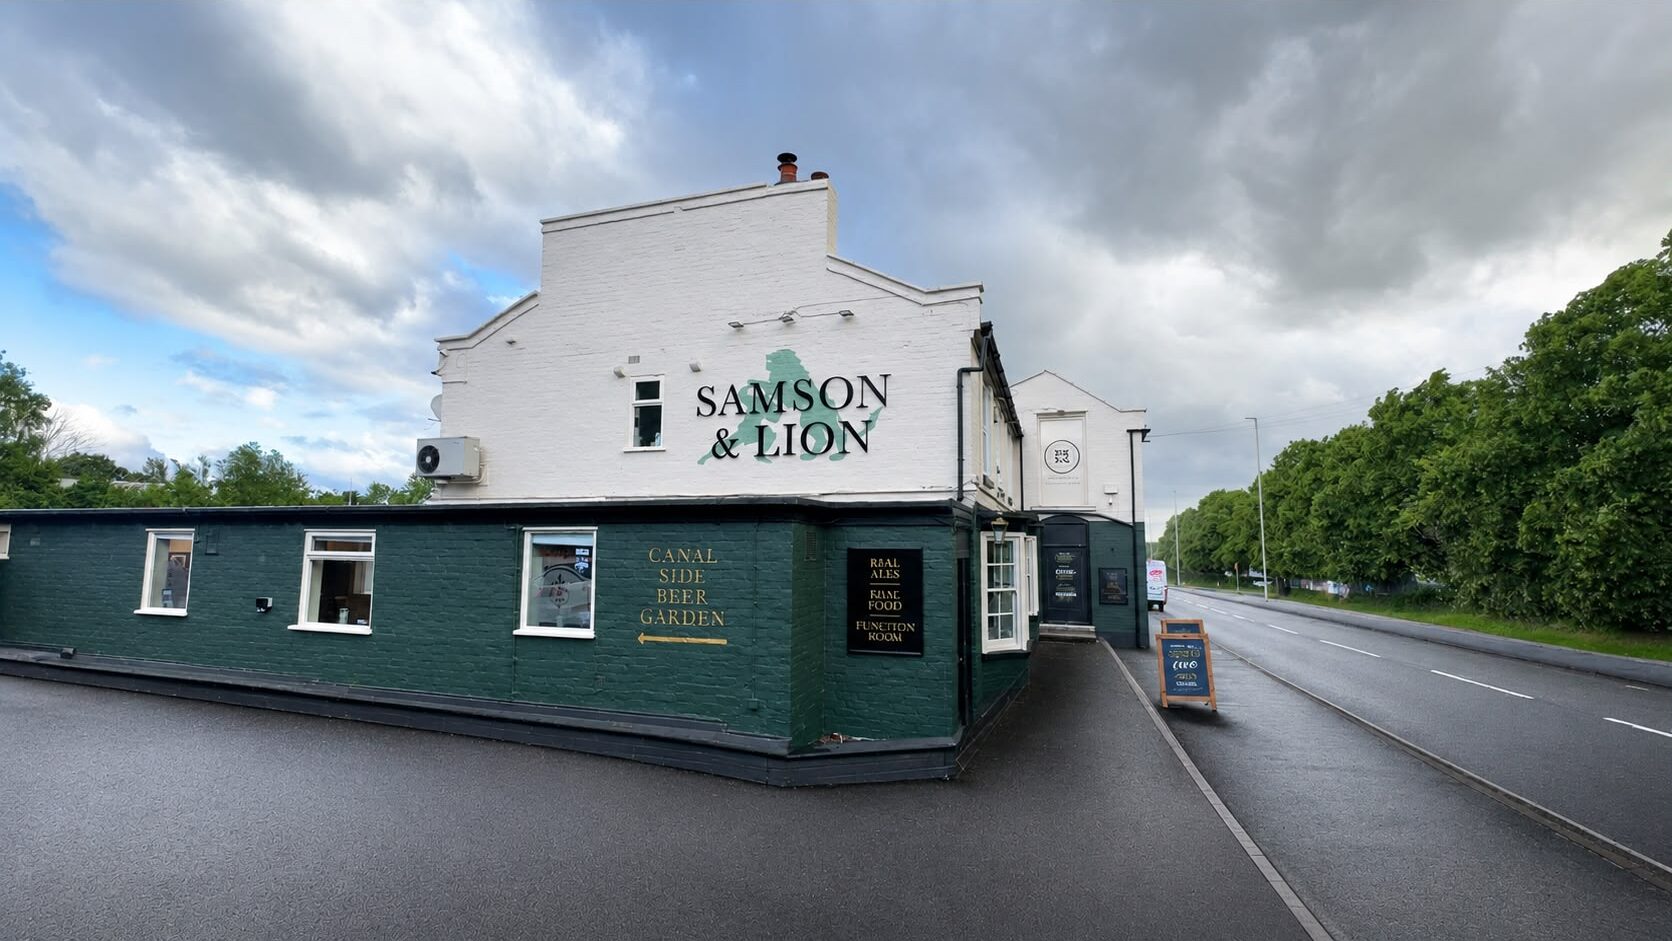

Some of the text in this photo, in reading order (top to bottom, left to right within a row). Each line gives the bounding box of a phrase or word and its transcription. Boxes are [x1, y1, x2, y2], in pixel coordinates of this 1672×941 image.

[697, 373, 892, 418] SAMSON
[711, 420, 873, 460] & LION
[648, 547, 718, 564] CANAL
[659, 568, 706, 584] SIDE
[870, 569, 901, 579] ALES
[657, 588, 709, 605] BEER
[868, 600, 903, 611] FOOD
[640, 607, 725, 627] GARDEN
[868, 632, 903, 642] ROOM
